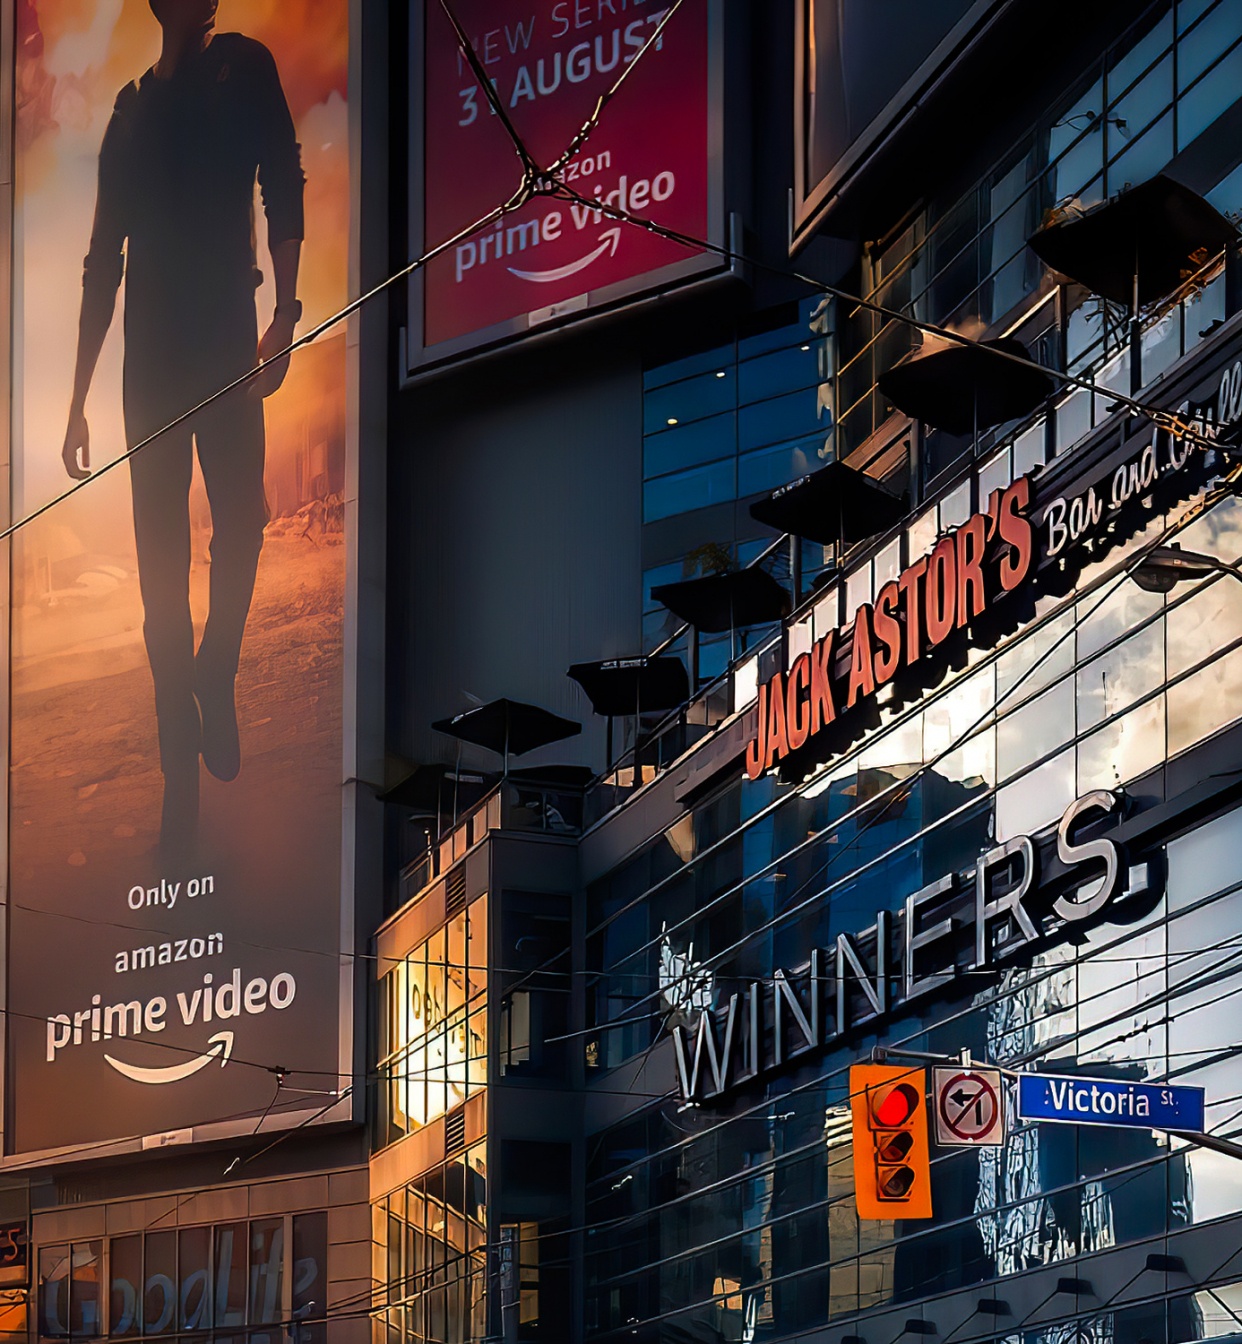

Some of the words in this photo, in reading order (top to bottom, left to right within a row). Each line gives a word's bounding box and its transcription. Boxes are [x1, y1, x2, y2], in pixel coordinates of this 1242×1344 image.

[510, 8, 670, 108] AUGUST
[532, 151, 611, 190] zon
[456, 211, 562, 282] prime
[570, 171, 675, 230] video
[746, 631, 836, 781] JACK
[847, 477, 1032, 708] ASTOR'S
[1043, 486, 1103, 556] Bar
[1111, 426, 1159, 508] and
[128, 879, 181, 909] Only
[187, 875, 214, 898] on
[115, 932, 223, 973] amazon
[673, 789, 1118, 1099] WINNERS
[47, 994, 166, 1062] prime
[177, 968, 296, 1026] video
[1050, 1079, 1149, 1117] Victoria
